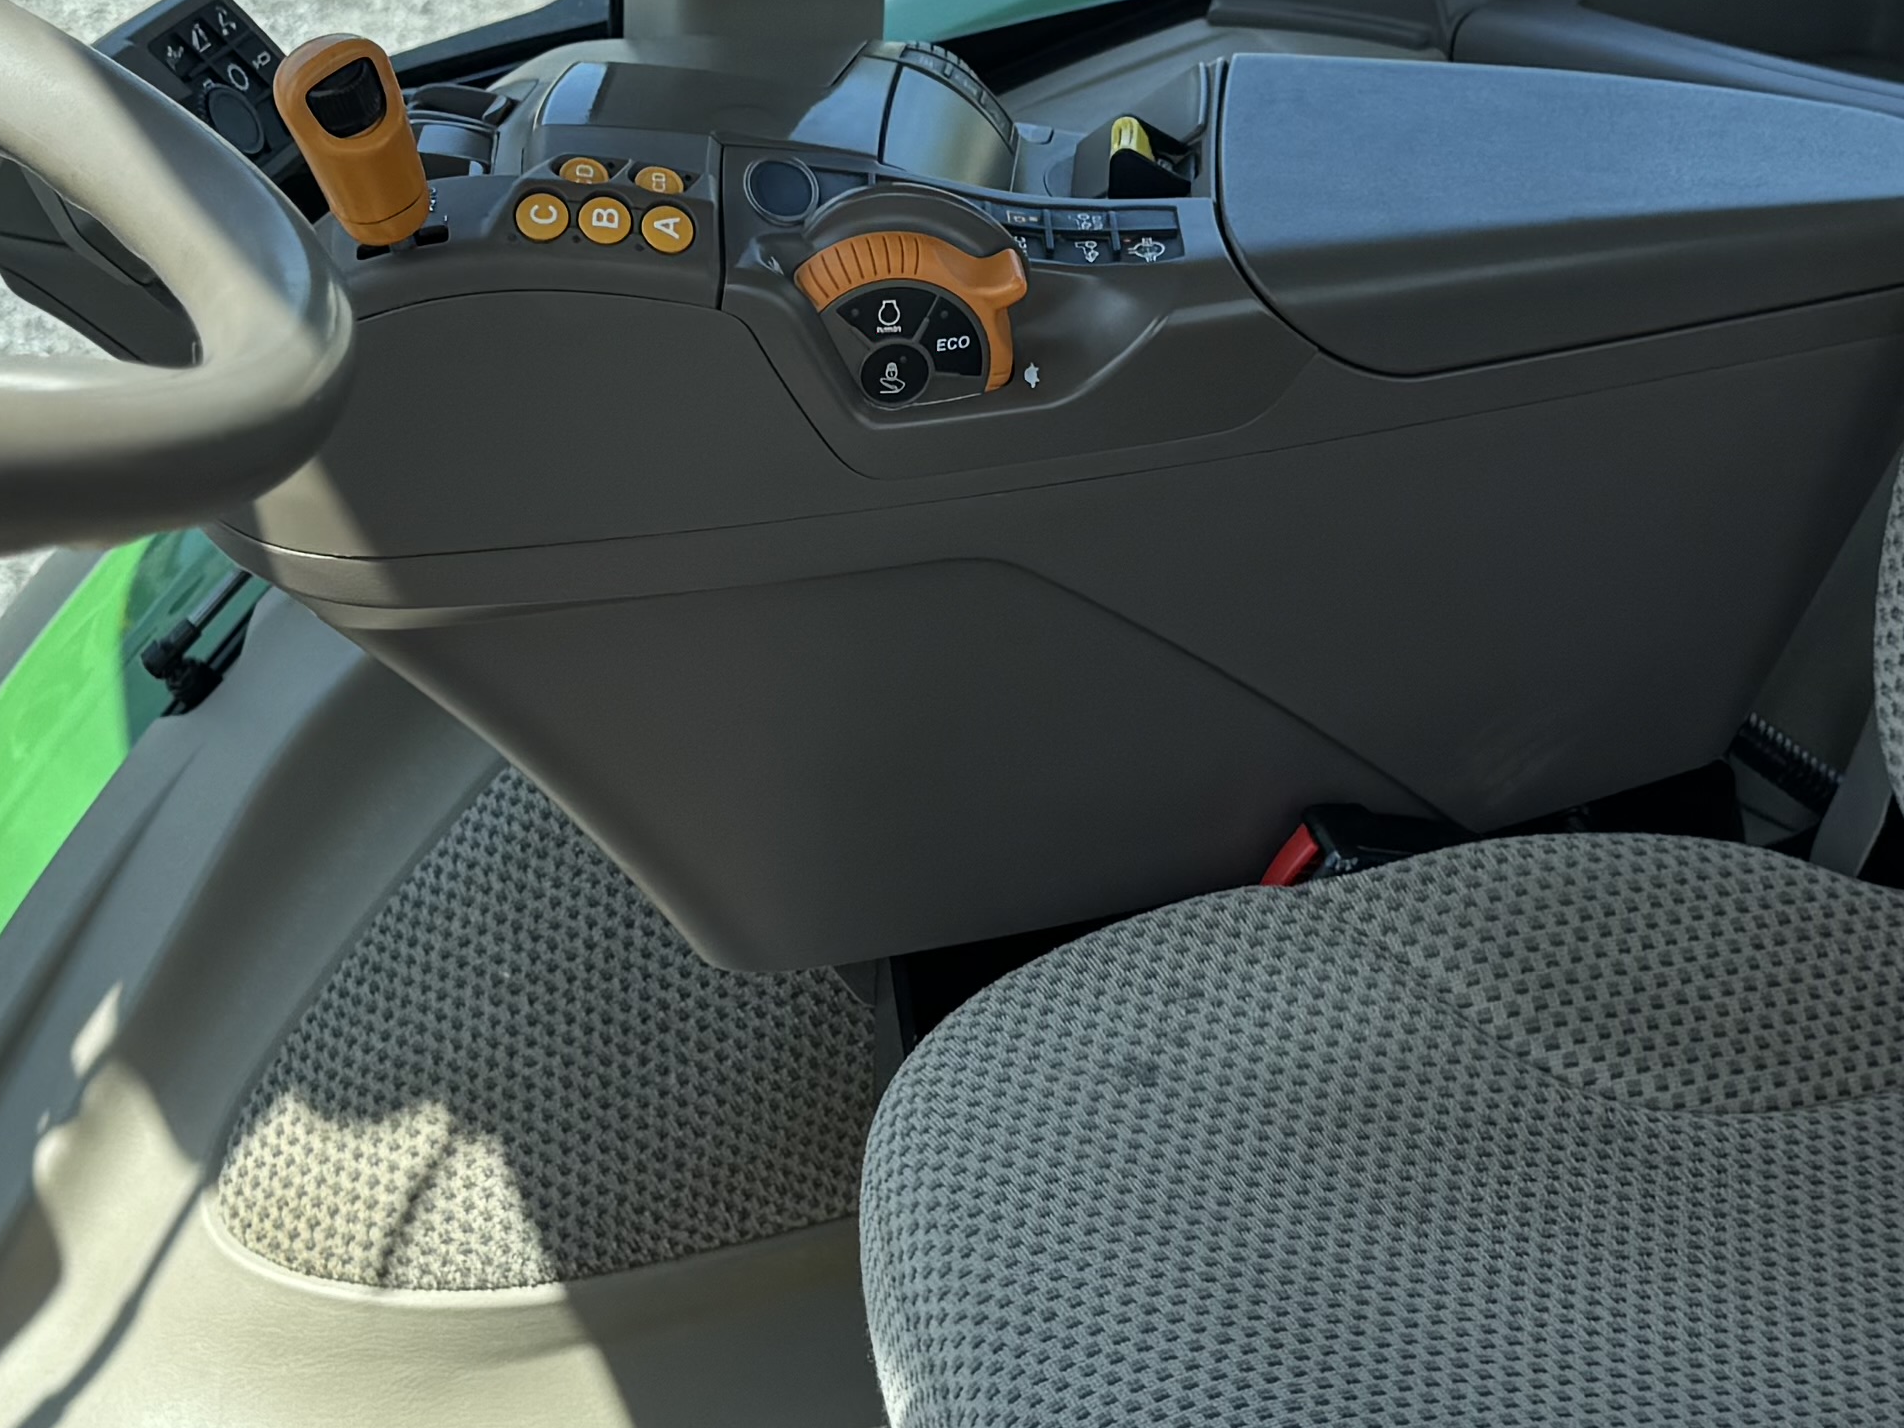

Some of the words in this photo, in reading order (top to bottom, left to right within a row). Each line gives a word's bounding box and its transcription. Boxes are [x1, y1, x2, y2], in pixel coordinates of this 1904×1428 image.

[529, 204, 558, 224] C
[592, 208, 619, 229] B
[653, 217, 681, 240] A
[936, 335, 971, 352] ECO
